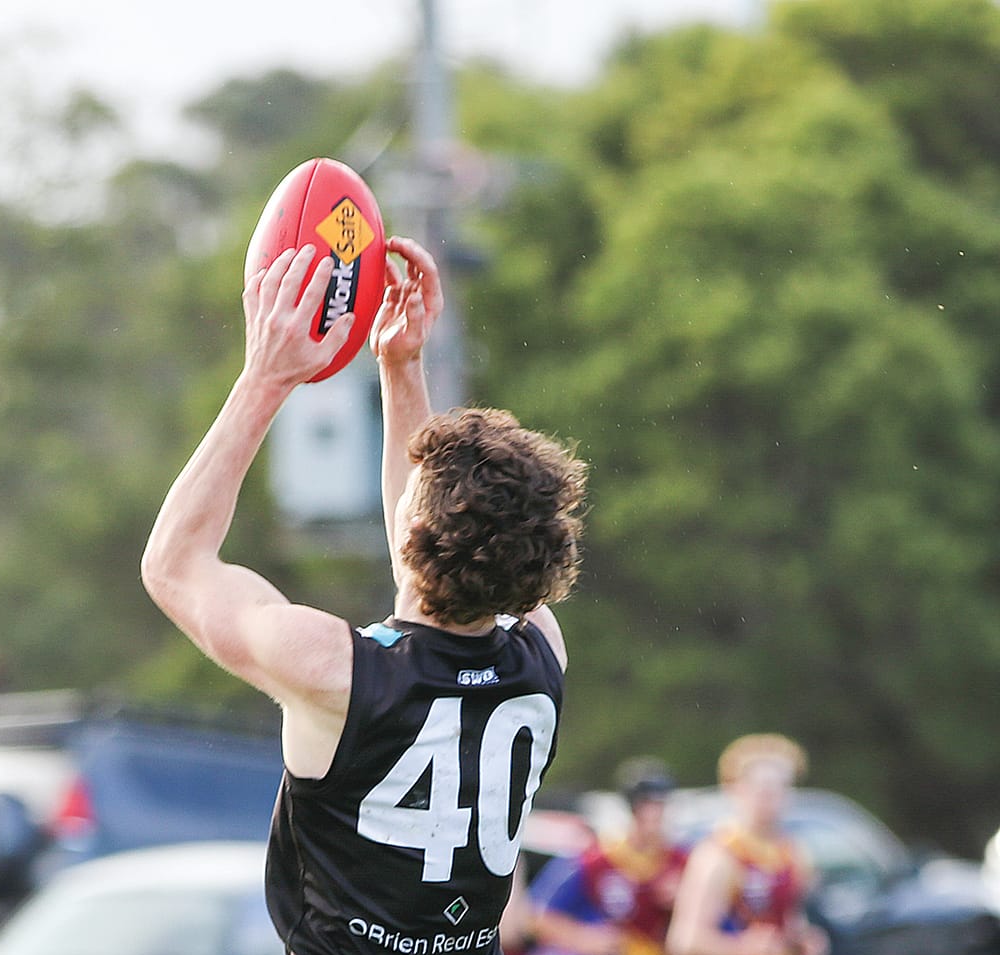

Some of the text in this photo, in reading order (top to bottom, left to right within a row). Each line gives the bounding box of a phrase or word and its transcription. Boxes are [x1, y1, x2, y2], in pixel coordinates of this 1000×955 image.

[358, 693, 557, 882] 40
[349, 918, 428, 955] OBrien
[432, 932, 475, 955] Real
